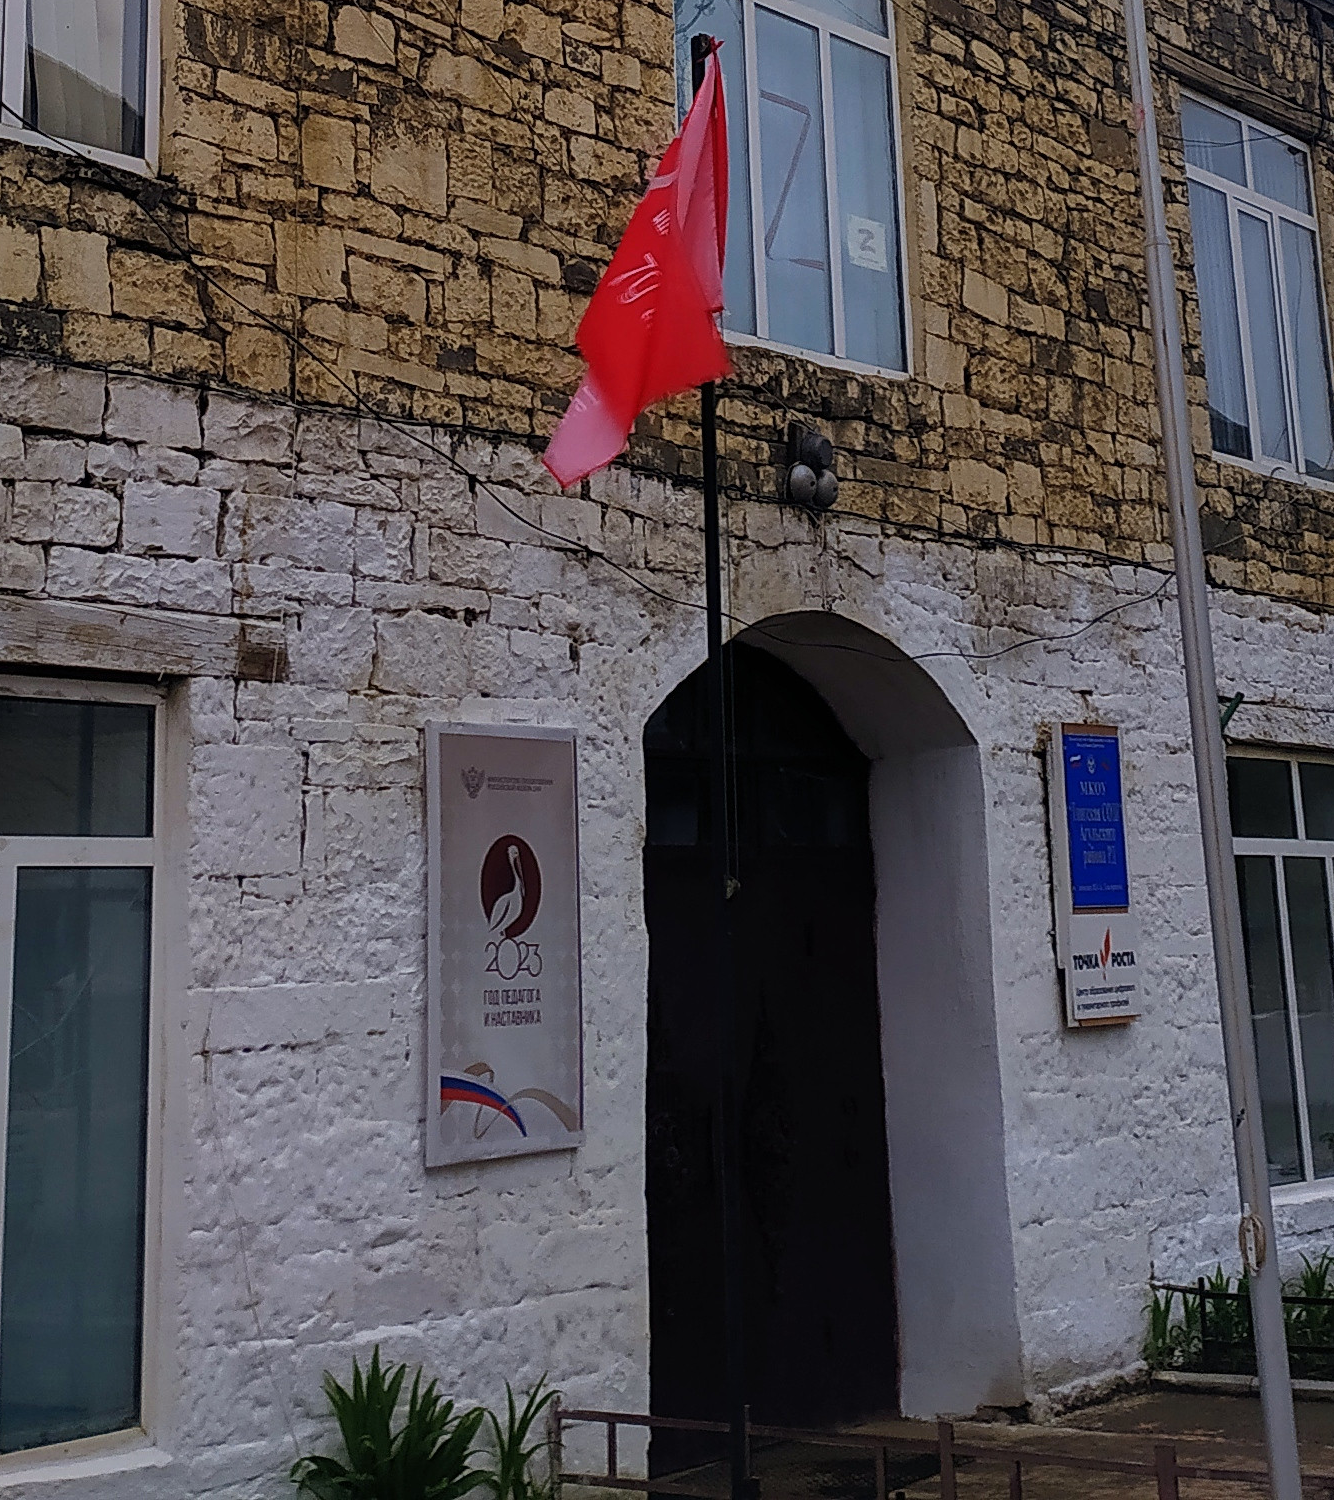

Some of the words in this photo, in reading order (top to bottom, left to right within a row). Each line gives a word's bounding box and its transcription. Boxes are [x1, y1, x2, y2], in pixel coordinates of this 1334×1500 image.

[485, 937, 542, 980] 2023
[1073, 954, 1100, 970] ТОЧКА
[1111, 951, 1136, 967] РОСТА
[483, 989, 500, 1005] ГОД
[501, 988, 542, 1005] ПЕДАГОГА
[491, 1009, 542, 1027] НАСТАВНИКА
